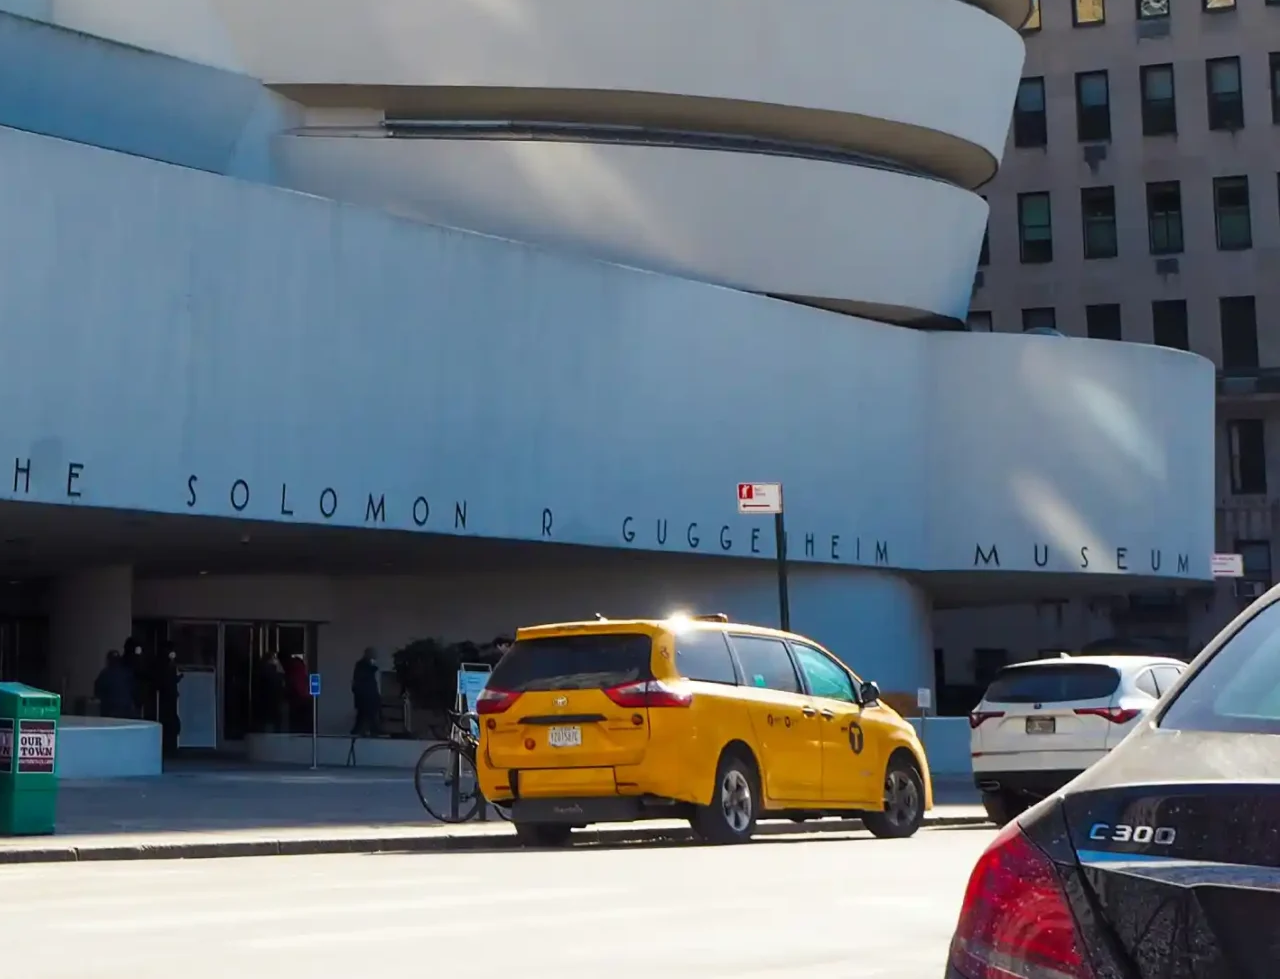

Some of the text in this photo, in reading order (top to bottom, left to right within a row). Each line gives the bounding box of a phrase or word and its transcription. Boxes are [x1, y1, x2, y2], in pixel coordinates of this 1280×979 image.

[187, 475, 467, 529] SOLOMON
[541, 508, 553, 537] R
[974, 543, 1189, 574] MUSEUM
[21, 736, 42, 747] OUR
[20, 747, 53, 757] TOWN
[1090, 823, 1176, 845] C 300
